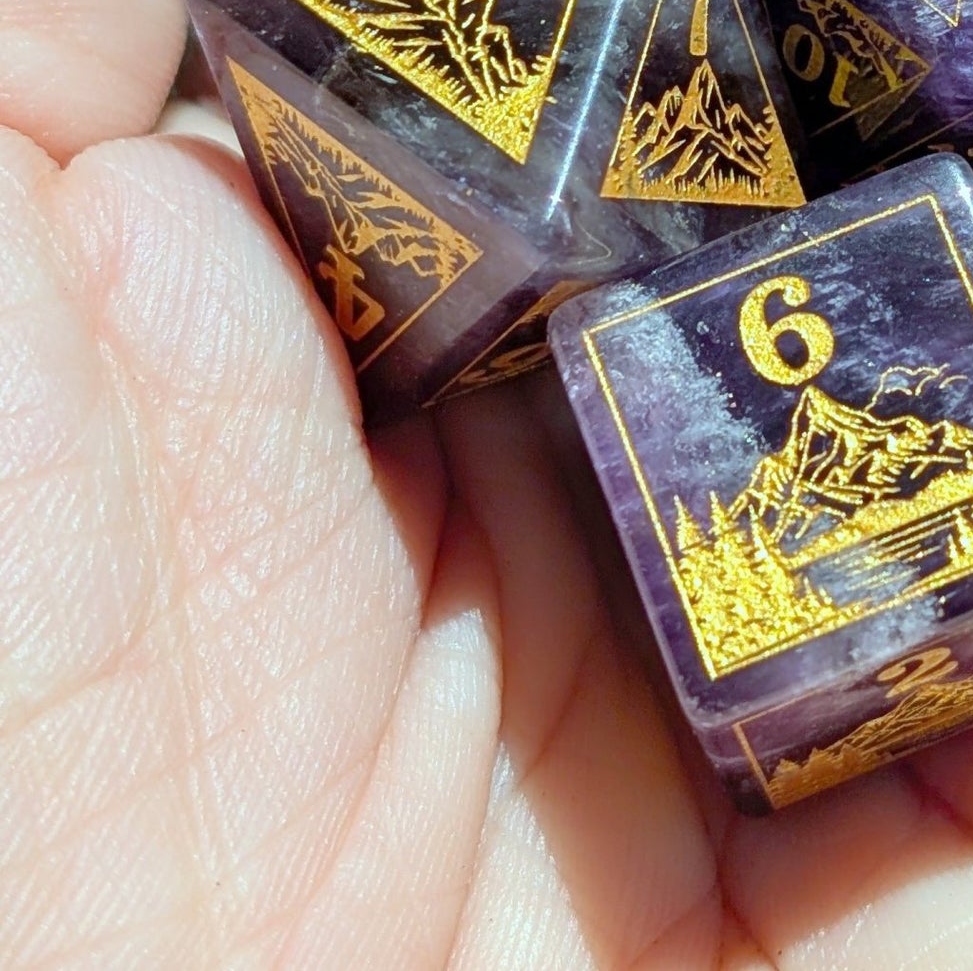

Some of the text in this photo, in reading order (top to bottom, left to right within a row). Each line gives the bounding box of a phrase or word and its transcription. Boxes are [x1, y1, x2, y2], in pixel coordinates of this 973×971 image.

[783, 23, 859, 108] 10
[319, 243, 386, 341] 4
[738, 276, 835, 385] 6
[877, 647, 959, 698] 2
